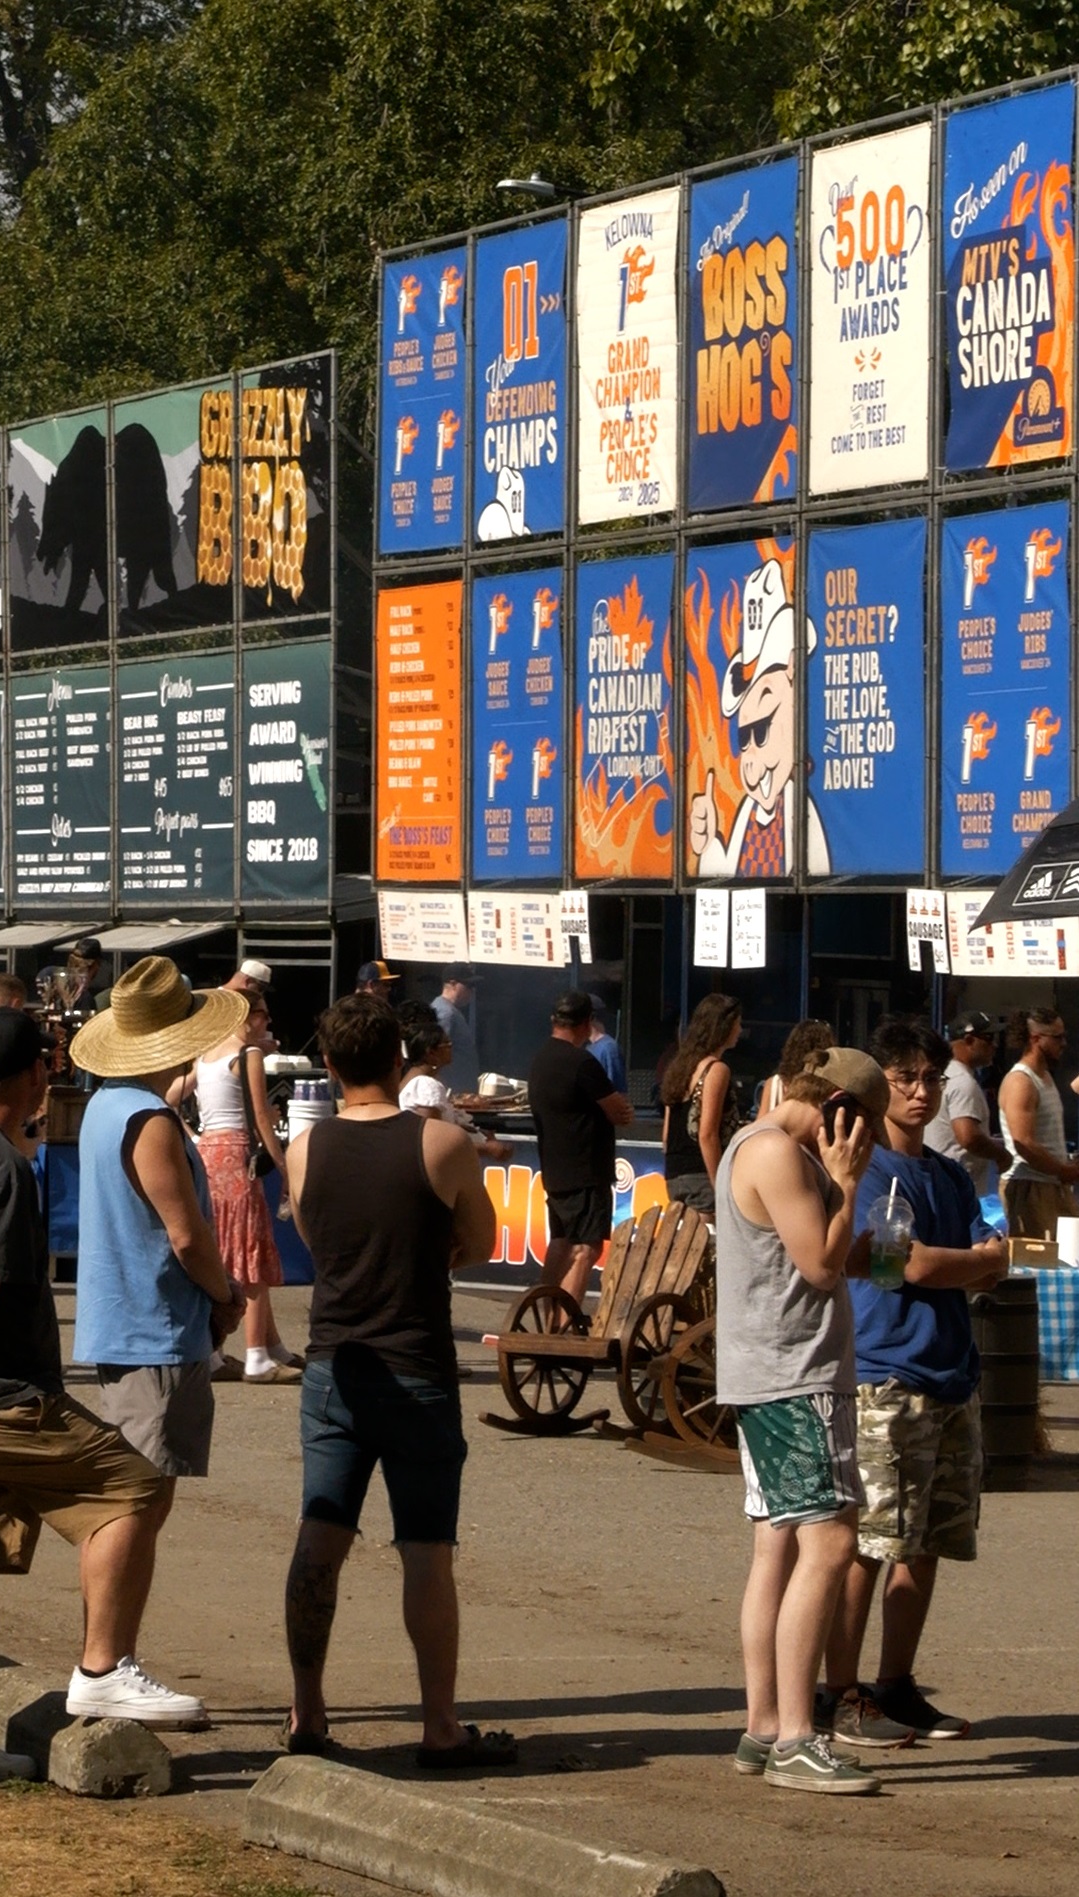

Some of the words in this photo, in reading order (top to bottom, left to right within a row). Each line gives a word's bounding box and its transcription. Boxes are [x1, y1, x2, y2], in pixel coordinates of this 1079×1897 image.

[950, 182, 978, 239] As
[980, 164, 1006, 210] seen
[1008, 141, 1028, 176] on
[604, 212, 653, 252] KELOWNA
[836, 184, 906, 271] 500
[856, 250, 908, 300] PLACE
[962, 238, 1020, 286] MTV'S
[702, 236, 788, 342] BOSS
[956, 268, 1052, 336] CANADA
[503, 260, 540, 363] 01
[840, 297, 900, 343] AWARDS
[608, 336, 650, 374] GRAND
[958, 325, 1034, 390] SHORE
[596, 366, 661, 409] CHAMPION
[697, 330, 793, 435] HOG'S
[852, 379, 885, 402] FORGET
[486, 380, 557, 423] DEFENDING
[866, 403, 886, 424] REST
[200, 387, 308, 458] GRIZZLY
[600, 412, 658, 452] PEOPLE'S
[484, 416, 558, 474] CHAMPS
[831, 434, 854, 454] COME
[856, 432, 866, 451] TO
[868, 429, 884, 450] THE
[886, 425, 906, 446] BEST
[606, 447, 650, 484] CHOICE
[393, 498, 414, 516] CHOICE
[434, 494, 452, 512] SAUCE
[637, 482, 660, 506] 2025
[198, 461, 308, 606] BBQ
[825, 568, 858, 607] OUR
[748, 598, 764, 630] 01
[825, 604, 899, 648] SECRET?
[958, 617, 996, 639] PEOPLE'S
[588, 634, 630, 674] PRIDE
[632, 642, 648, 670] OF
[962, 639, 994, 660] CHOICE
[1024, 634, 1046, 654] RIBS
[526, 676, 553, 694] CHICKEN
[824, 654, 850, 686] THE
[852, 651, 883, 684] RUB,
[249, 680, 302, 708] SERVING
[488, 680, 508, 696] SAUCE
[588, 673, 662, 714] CANADIAN
[824, 688, 850, 720] THE
[852, 686, 890, 720] LOVE,
[249, 720, 296, 746] AWARD
[588, 716, 648, 754] RIBFEST
[840, 722, 865, 754] THE
[866, 721, 896, 752] GOD
[248, 759, 303, 785] WINNING
[824, 758, 874, 790] ABOVE!
[247, 800, 276, 825] BBQ
[956, 792, 996, 812] PEOPLE'S
[1020, 790, 1052, 810] GRAND
[389, 826, 402, 845] THE
[428, 826, 452, 844] FEAST
[487, 827, 510, 844] CHOICE
[528, 826, 552, 842] CHOICE
[961, 814, 992, 834] CHOICE
[247, 838, 284, 862] SINCE
[288, 838, 318, 862] 2018
[1022, 885, 1054, 898] adidas
[908, 921, 944, 940] SAUSAGE
